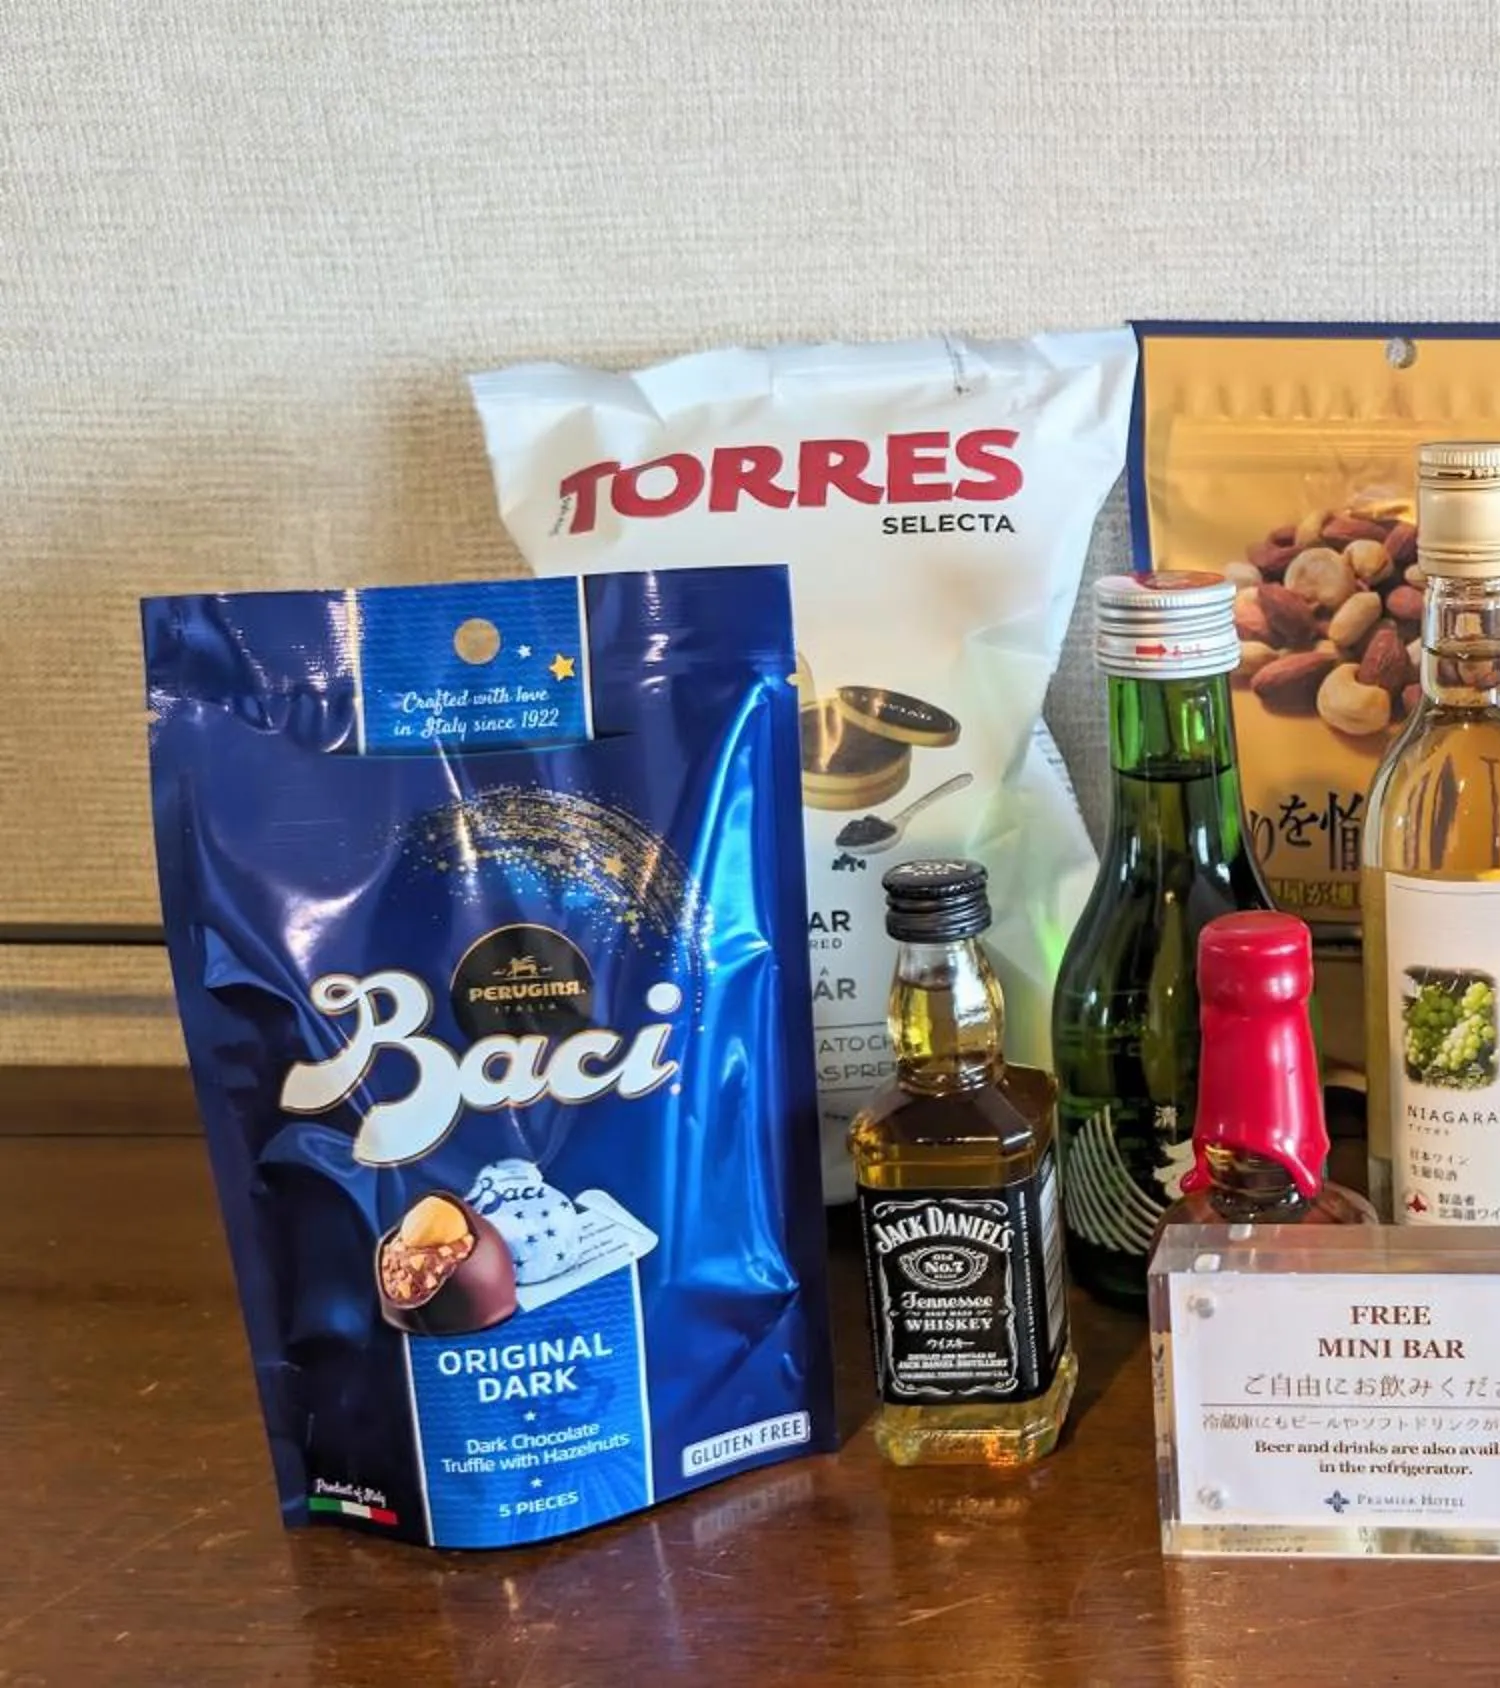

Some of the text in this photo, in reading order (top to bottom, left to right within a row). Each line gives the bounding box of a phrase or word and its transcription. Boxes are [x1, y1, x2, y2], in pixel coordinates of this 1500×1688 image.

[559, 428, 1024, 536] TORRES
[881, 512, 1017, 536] SELECTA
[402, 685, 549, 717] Crafted with love
[393, 707, 560, 742] in Italy since 1922
[469, 980, 580, 1002] PERUGINA
[281, 970, 679, 1167] Baci
[1407, 1104, 1499, 1125] NIAGARA
[468, 1177, 546, 1214] Baci
[872, 1213, 928, 1254] JACK
[901, 1291, 994, 1310] Tennessee
[1350, 1305, 1431, 1326] FREE
[904, 1317, 994, 1333] WHISKEY
[438, 1332, 613, 1376] ORIGINAL
[1318, 1337, 1466, 1360] MINI BAR
[477, 1365, 579, 1403] DARK
[441, 1432, 630, 1473] Truffle with Hazelnuts
[466, 1422, 600, 1454] Dark Chocolate
[691, 1419, 803, 1466] GLUTEN FREE
[1255, 1441, 1295, 1454] Beer
[1297, 1440, 1331, 1455] and
[1333, 1440, 1389, 1455] drinks
[1391, 1446, 1420, 1456] are
[1422, 1442, 1457, 1457] also
[1319, 1460, 1473, 1477] in the refrigerator.
[500, 1491, 579, 1517] 5 PIECES
